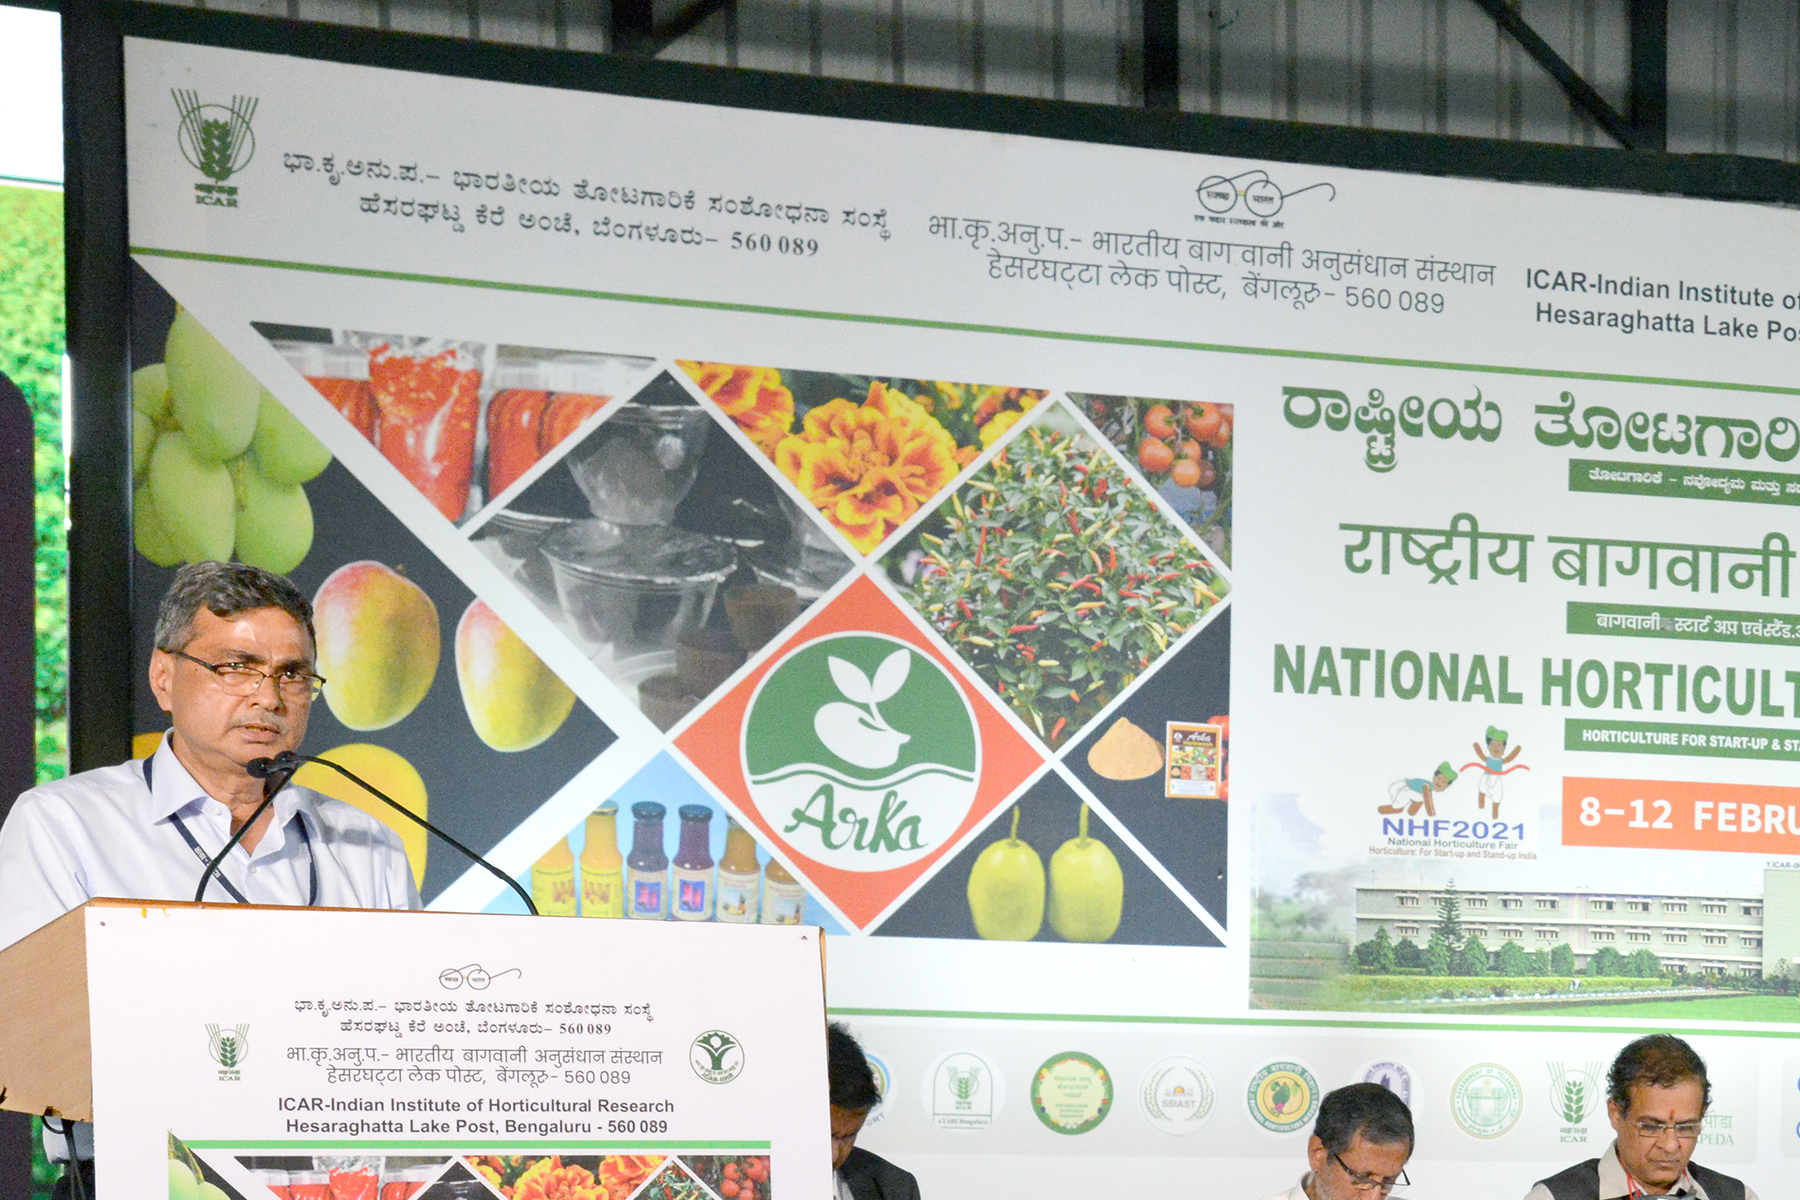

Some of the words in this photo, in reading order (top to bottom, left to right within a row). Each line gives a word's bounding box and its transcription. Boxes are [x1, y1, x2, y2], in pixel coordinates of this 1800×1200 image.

[195, 195, 239, 208] ICAR
[453, 171, 560, 197] ಭಾರತೀಯ
[574, 179, 695, 210] ತೋಟಗಾರಿಕೆ
[709, 195, 829, 224] ಸಂಶೋಧನಾ
[1527, 268, 1669, 299] ICAR-Indian
[1679, 281, 1774, 307] Institute
[1537, 302, 1694, 334] Hesaraghatta
[1704, 315, 1758, 338] Lake
[1281, 385, 1503, 474] ರಾಷ್ಟ್ರೀಯ
[1339, 512, 1534, 585] राष्ट्रीय
[1547, 532, 1796, 598] बागवानी
[1274, 644, 1523, 704] NATIONAL
[1582, 729, 1679, 745] HORTICULTURE
[1681, 734, 1706, 747] FOR
[1709, 735, 1768, 750] START-UP
[1771, 739, 1781, 750] &
[784, 783, 928, 853] Arka
[1383, 818, 1523, 840] NHF2021
[1388, 837, 1431, 847] National
[1434, 839, 1495, 849] Horticulture
[1499, 841, 1518, 849] Fair
[279, 1097, 384, 1111] ICAR-Indian
[391, 1098, 460, 1111] Institute
[467, 1098, 483, 1112] of
[489, 1099, 591, 1112] Horticultural
[598, 1099, 674, 1112] Research
[1162, 1098, 1196, 1109] SSIAST
[287, 1119, 403, 1136] Hesaraghatta
[410, 1120, 450, 1133] Lake
[457, 1120, 498, 1135] Post,
[505, 1120, 591, 1136] Bengaluru
[1559, 1135, 1588, 1143] ICAR
